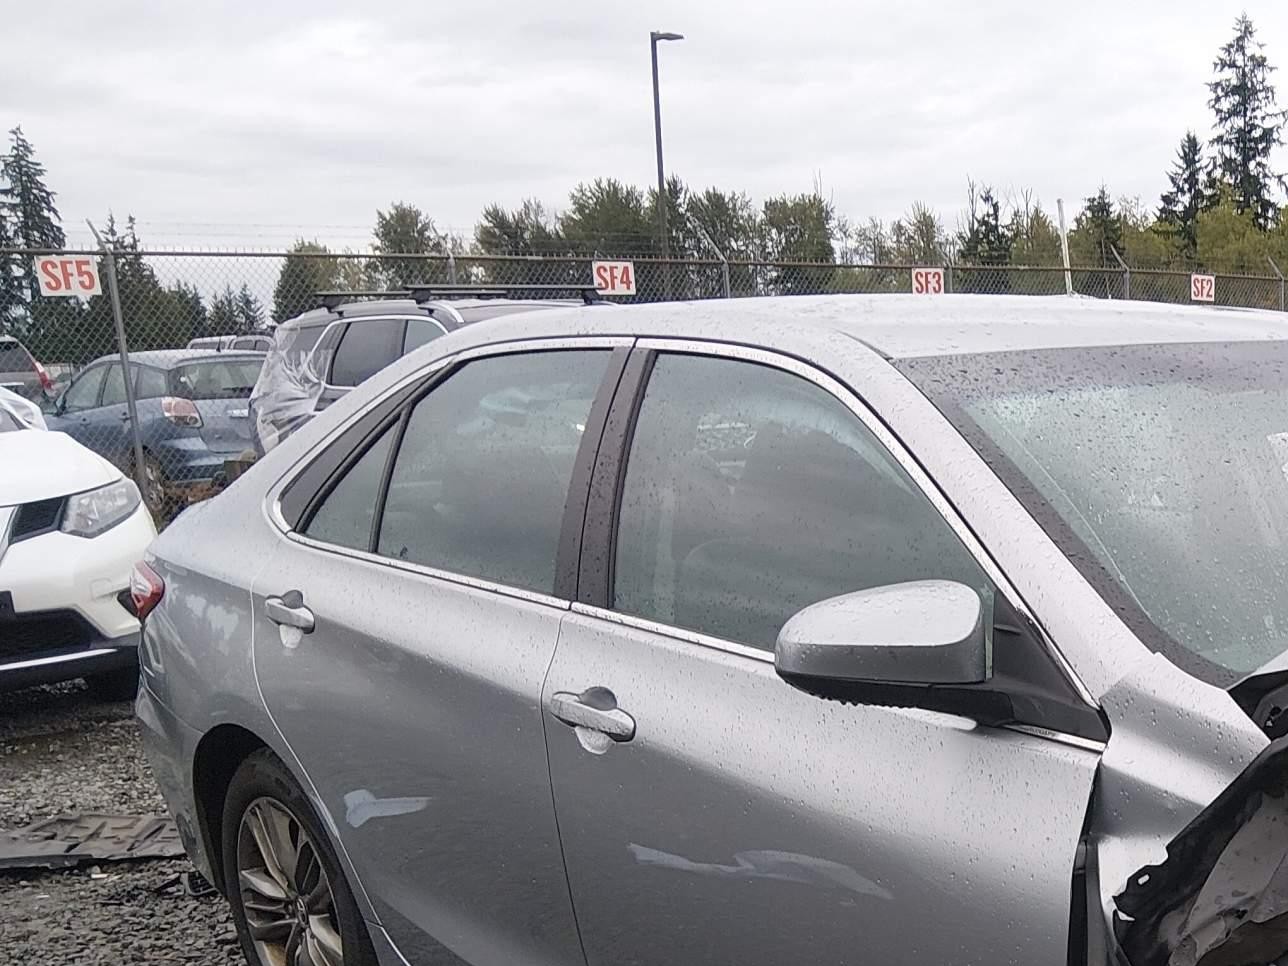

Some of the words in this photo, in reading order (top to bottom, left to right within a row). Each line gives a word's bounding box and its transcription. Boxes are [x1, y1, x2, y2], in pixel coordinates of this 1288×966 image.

[41, 260, 95, 291] SF5
[596, 265, 632, 290] SF4
[915, 271, 942, 294] SF3
[1193, 278, 1213, 298] SF2
